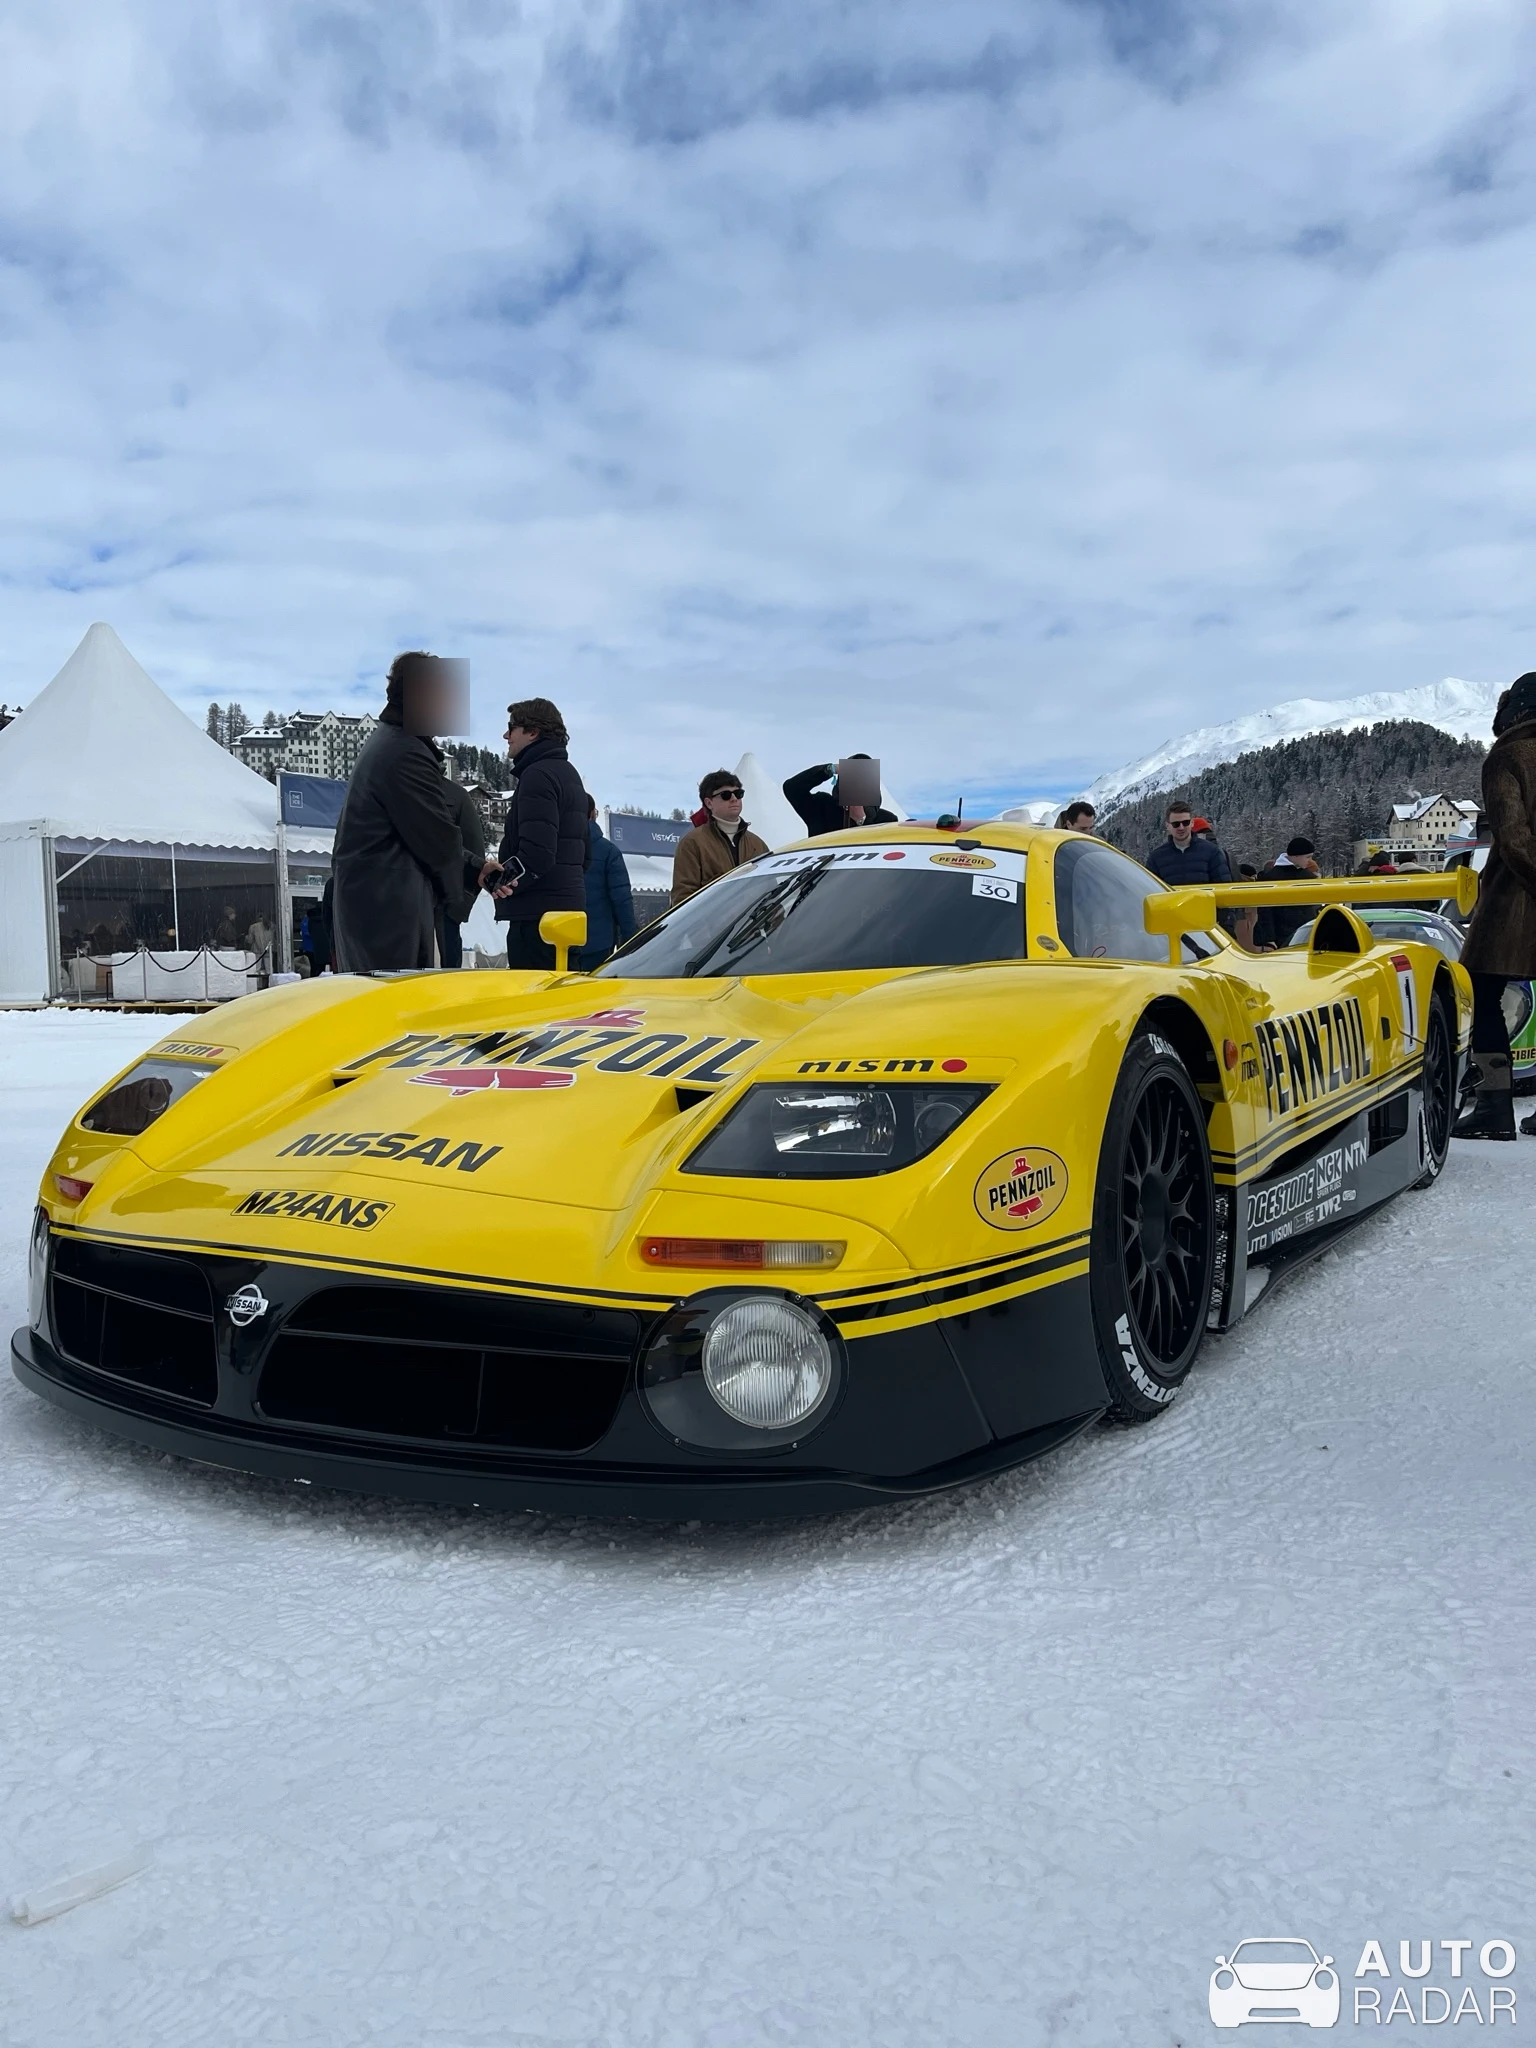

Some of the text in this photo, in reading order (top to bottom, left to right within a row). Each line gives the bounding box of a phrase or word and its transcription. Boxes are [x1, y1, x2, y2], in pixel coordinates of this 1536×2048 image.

[938, 857, 986, 865] PENNZOIL
[979, 883, 1011, 899] 30
[342, 1030, 763, 1084] PENNZOIL
[1255, 997, 1371, 1125] PENNZOIL
[275, 1132, 504, 1173] NISSAN
[1316, 1149, 1342, 1190] NGK
[1345, 1137, 1367, 1173] NTN
[988, 1165, 1056, 1211] PENNZOIL
[235, 1191, 389, 1228] M24ANS
[1271, 1221, 1293, 1245] VISION
[226, 1296, 262, 1312] NISSAN
